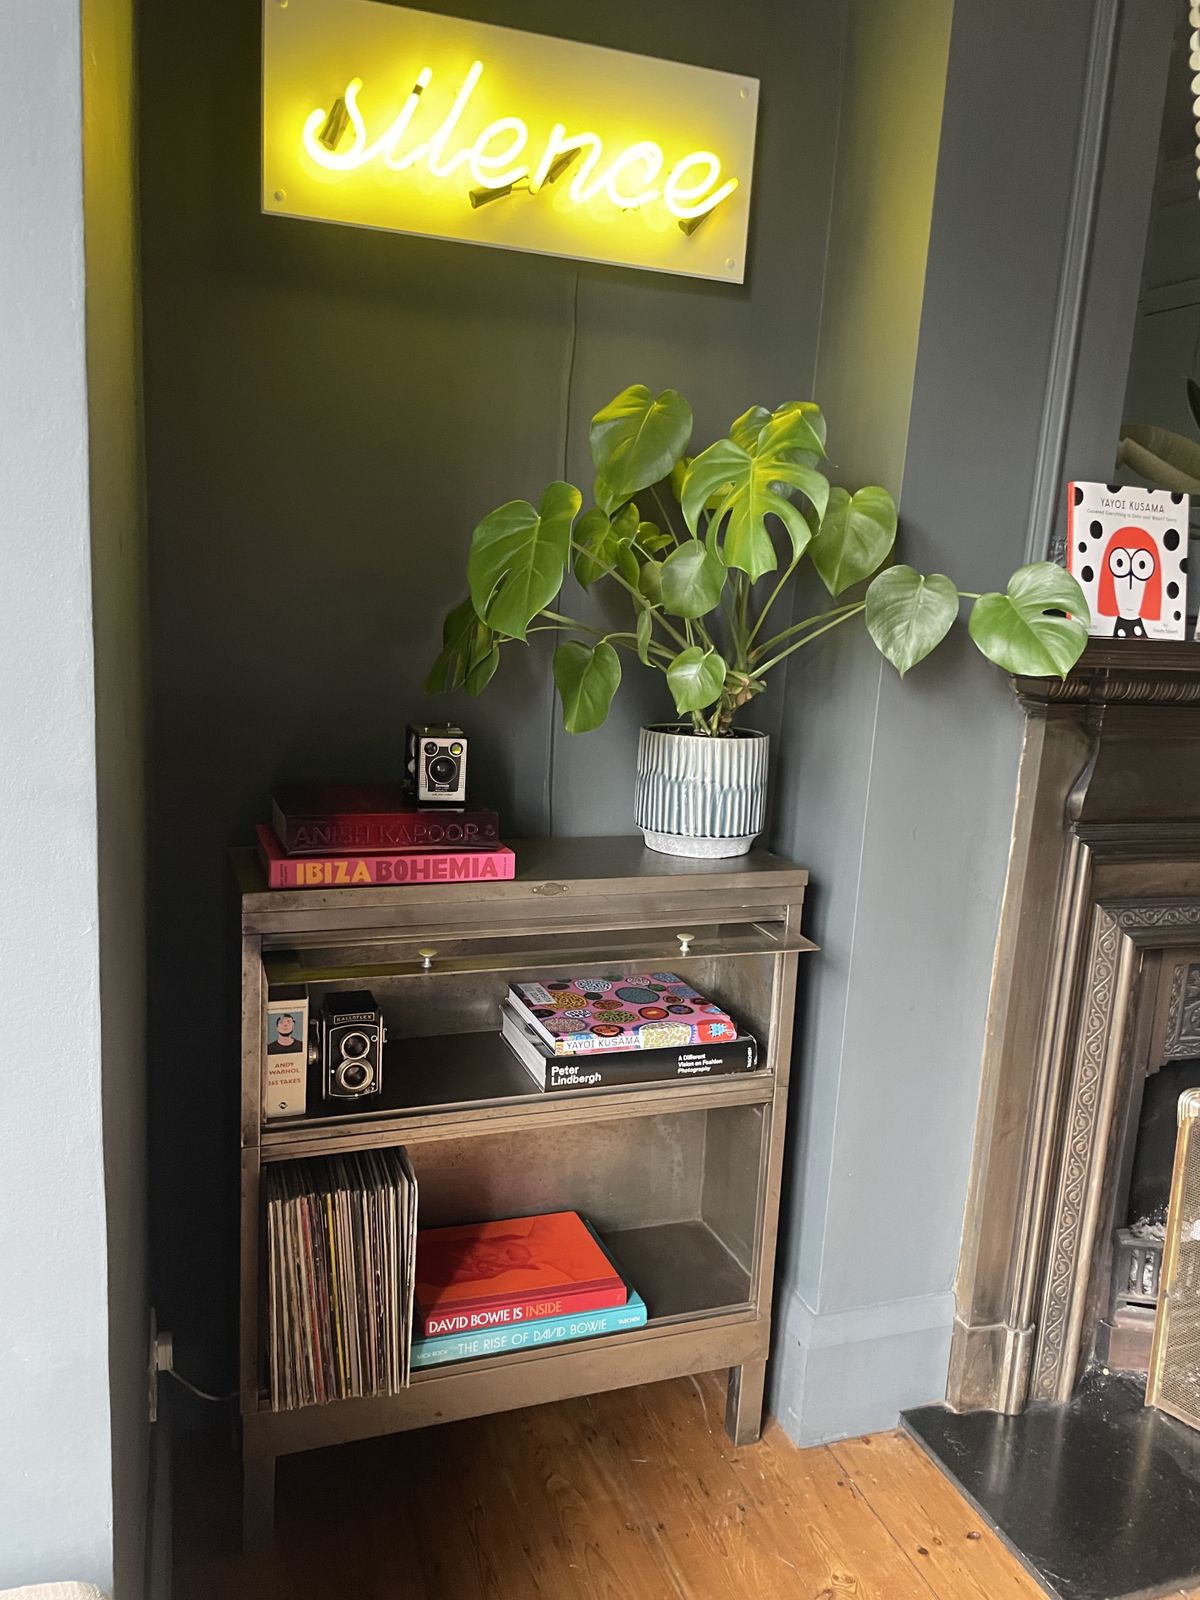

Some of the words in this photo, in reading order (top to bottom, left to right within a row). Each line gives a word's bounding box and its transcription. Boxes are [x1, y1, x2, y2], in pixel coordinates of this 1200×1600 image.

[302, 60, 740, 220] silence
[1101, 497, 1126, 510] YAYOI
[1129, 502, 1165, 514] KUSAMA
[382, 823, 480, 845] KAPOOR
[296, 861, 372, 885] IBIZA
[375, 857, 499, 882] BOHEMIA
[566, 1040, 595, 1050] YAYOI
[598, 1036, 640, 1047] KUSAMA
[683, 1053, 706, 1061] Different
[269, 1068, 299, 1076] WARHOL
[551, 1066, 580, 1077] Peter
[677, 1066, 712, 1074] Photography
[280, 1078, 301, 1086] TAKES
[551, 1072, 602, 1086] Lindbergh
[429, 1315, 468, 1334] DAVID
[471, 1308, 510, 1326] BOWIE
[513, 1307, 523, 1319] IS
[525, 1301, 562, 1317] INSIDE
[618, 1315, 640, 1325] TASCHEN
[458, 1341, 479, 1354] THE
[484, 1336, 507, 1350] RISE
[511, 1332, 528, 1346] OF
[533, 1326, 566, 1341] DAVID
[570, 1319, 607, 1335] BOWIE
